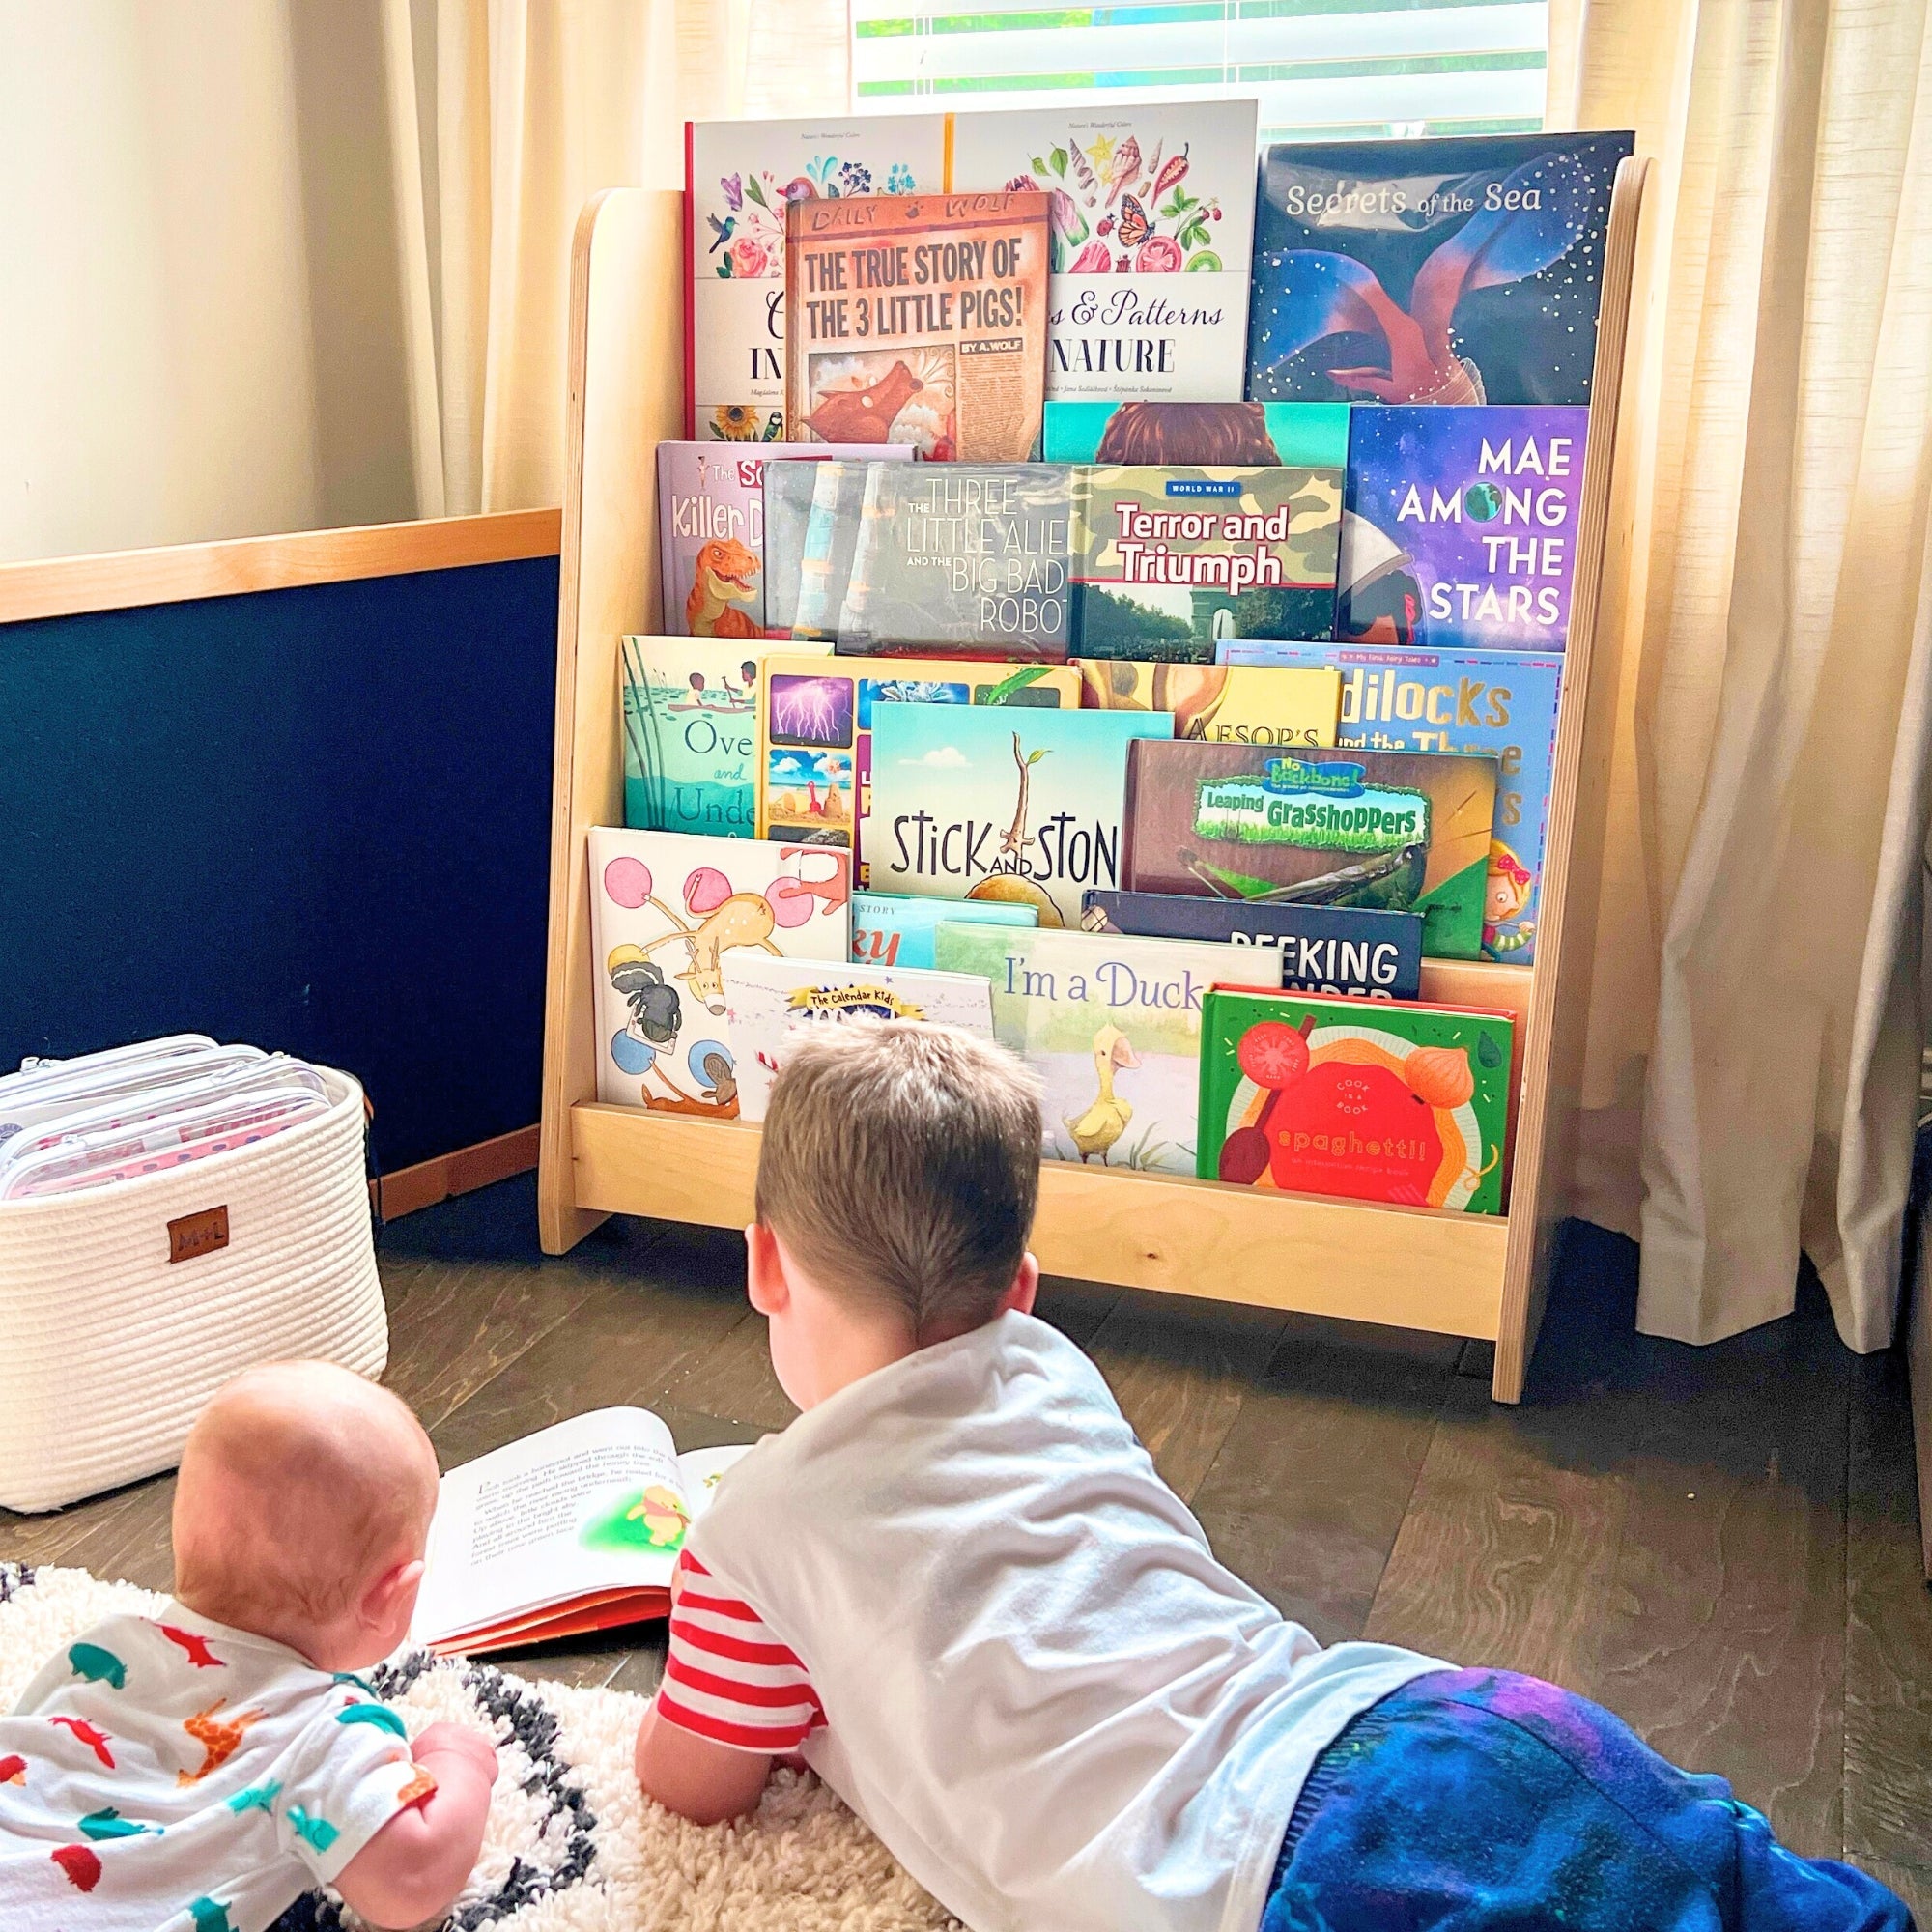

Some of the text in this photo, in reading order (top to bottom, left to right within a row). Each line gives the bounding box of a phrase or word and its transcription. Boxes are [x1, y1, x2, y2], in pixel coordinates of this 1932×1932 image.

[812, 194, 1015, 231] DAILY WOLF
[1286, 182, 1542, 217] Secrets of the Sea
[804, 238, 1022, 293] THE TRUE STORY OF
[806, 299, 850, 339] THE
[855, 298, 870, 337] 3
[877, 292, 953, 336] LITTLE
[960, 286, 1023, 330] PIGS!
[1071, 290, 1099, 326] &
[1101, 288, 1225, 326] Patterns
[748, 348, 784, 380] IN
[961, 343, 978, 354] BY
[1050, 338, 1176, 373] NATURE
[712, 464, 736, 482] The
[1478, 435, 1573, 476] MAE
[908, 502, 930, 514] THE
[925, 477, 1018, 515] THREE
[672, 495, 745, 539] Killer
[1116, 503, 1290, 541] Terror and
[906, 518, 1070, 554] LITTLE ALIE
[906, 556, 952, 567] AND THE
[1117, 542, 1283, 597] Triumph
[1482, 535, 1565, 576] THE
[952, 557, 1065, 595] BIG BAD
[1428, 582, 1561, 626] STARS
[713, 763, 748, 781] and
[1281, 757, 1301, 772] No
[1208, 792, 1264, 813] Leaping
[1267, 800, 1417, 835] Grasshoppers
[860, 904, 896, 916] STORY
[810, 989, 895, 1006] The Calendar Kids
[1004, 956, 1204, 1012] I'm a Duck
[1336, 1078, 1371, 1093] COOK
[1336, 1101, 1369, 1115] BOOK
